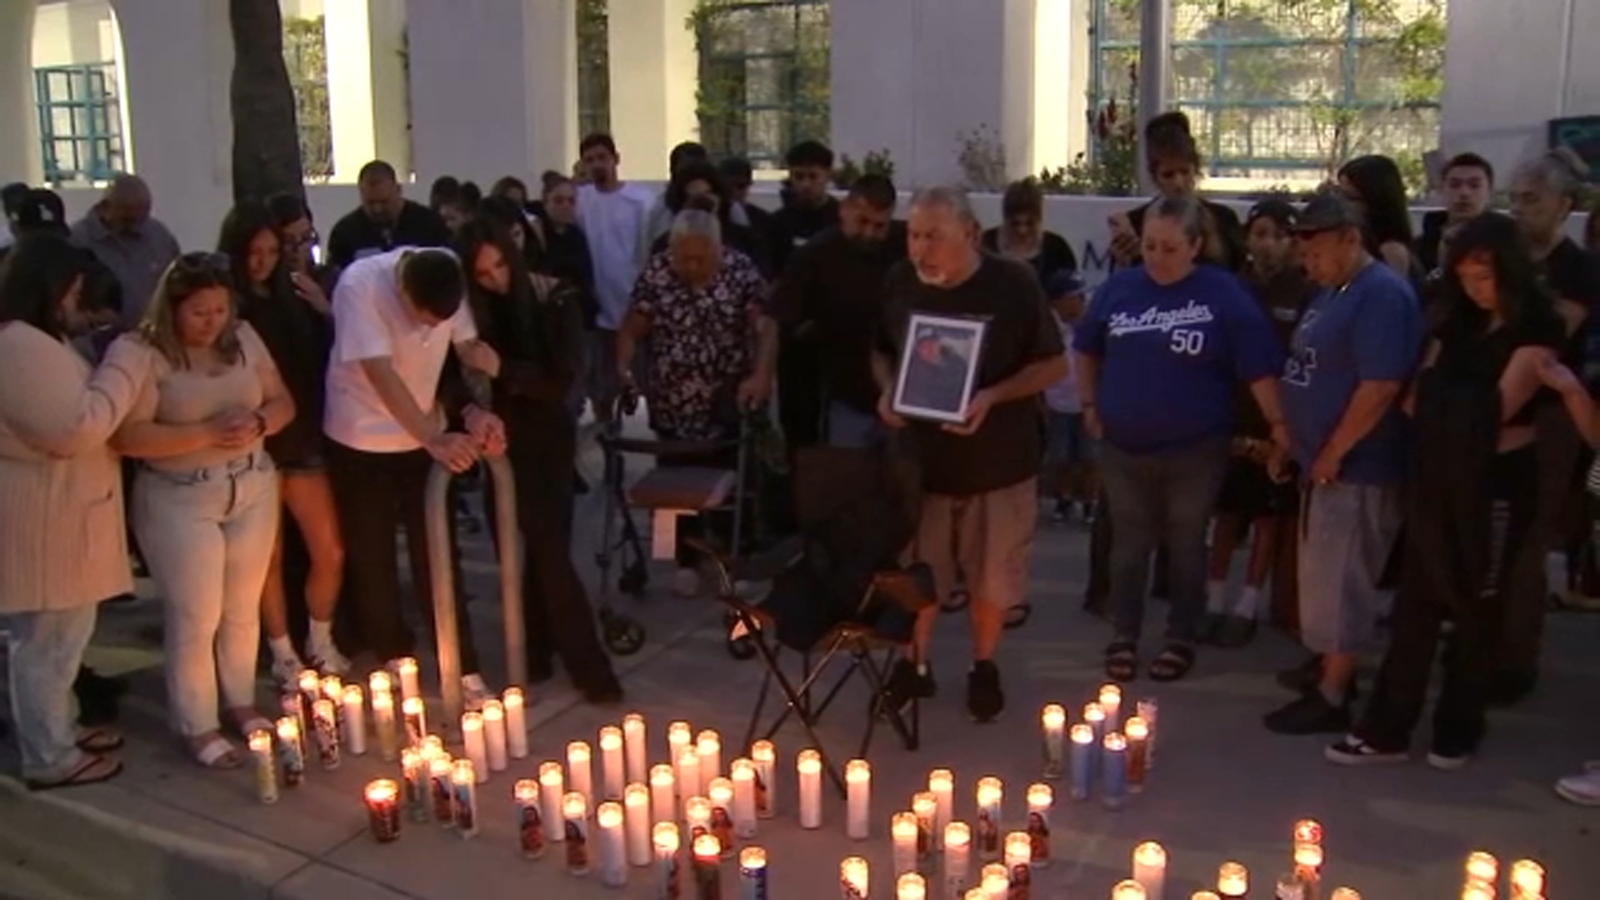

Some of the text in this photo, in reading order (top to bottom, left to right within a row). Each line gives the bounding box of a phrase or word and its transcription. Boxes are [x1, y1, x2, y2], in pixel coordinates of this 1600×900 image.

[1109, 300, 1213, 332] Los Angeles
[1170, 328, 1204, 355] 50
